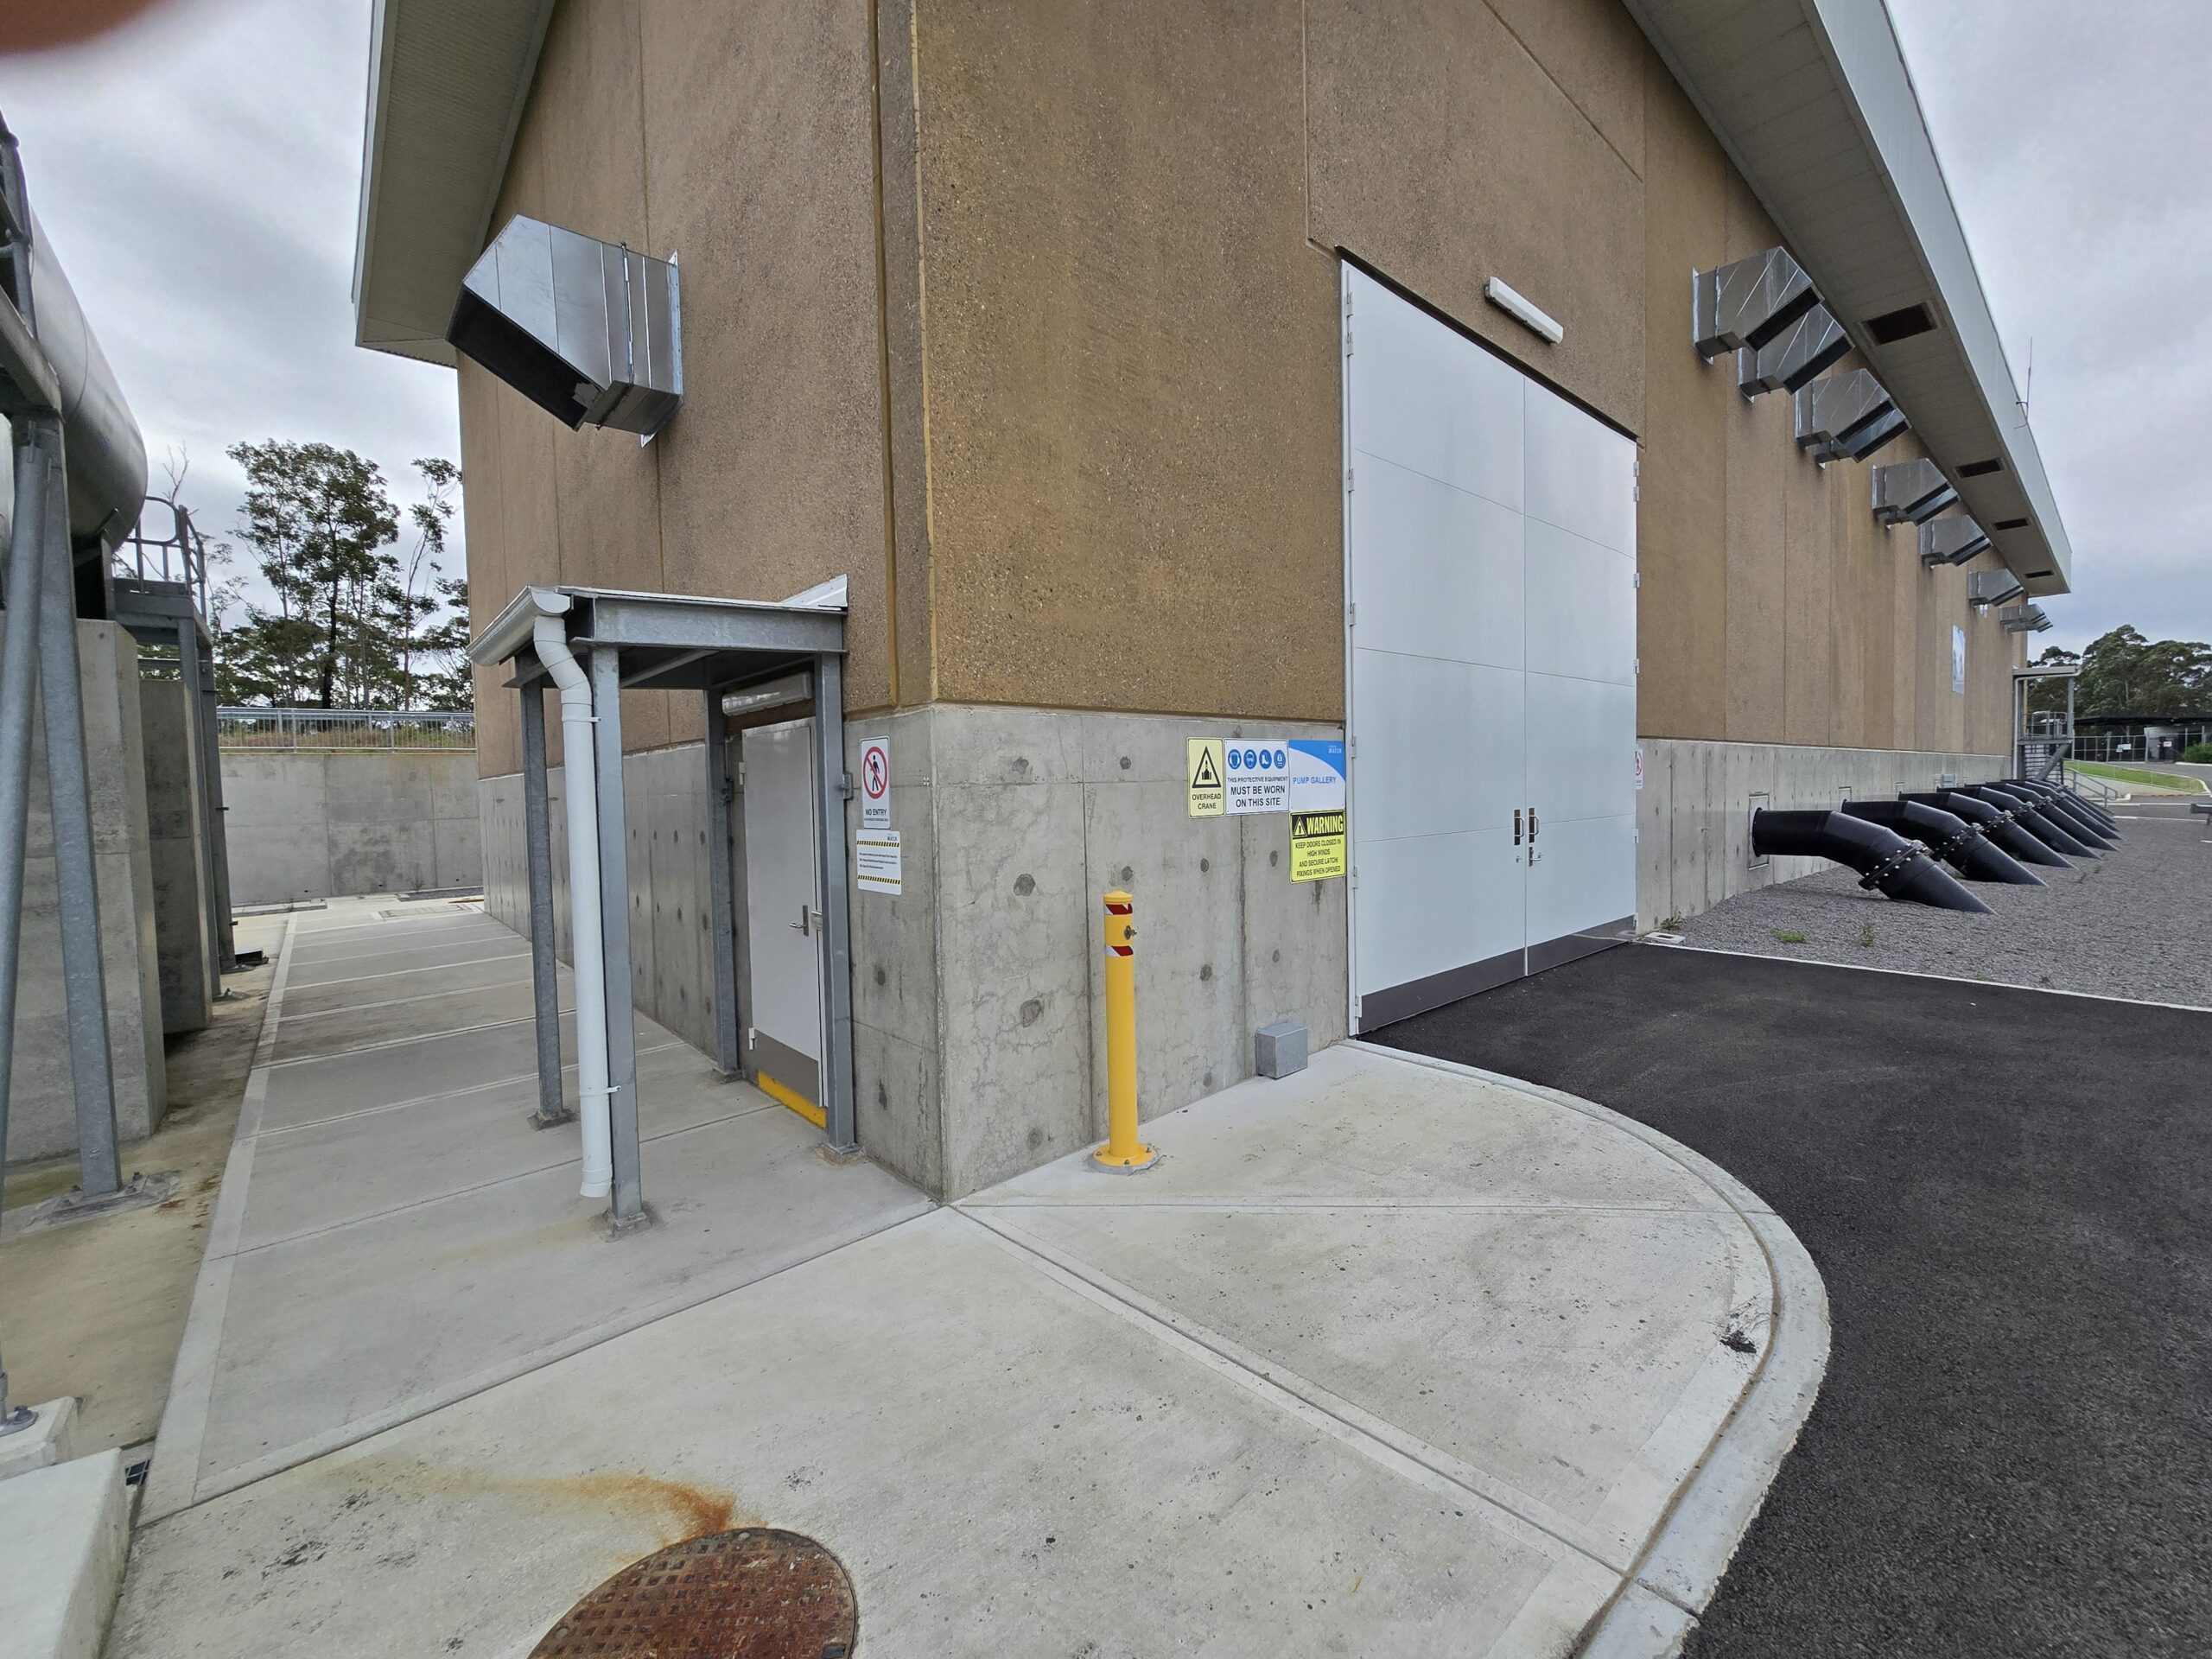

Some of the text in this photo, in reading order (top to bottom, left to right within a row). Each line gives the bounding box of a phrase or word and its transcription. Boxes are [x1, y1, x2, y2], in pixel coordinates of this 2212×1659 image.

[1230, 785, 1286, 795] MUST BE WORN
[1236, 798, 1281, 808] ON THIS SITE
[1306, 815, 1344, 835] WARNING
[1325, 865, 1341, 874] OPENED
